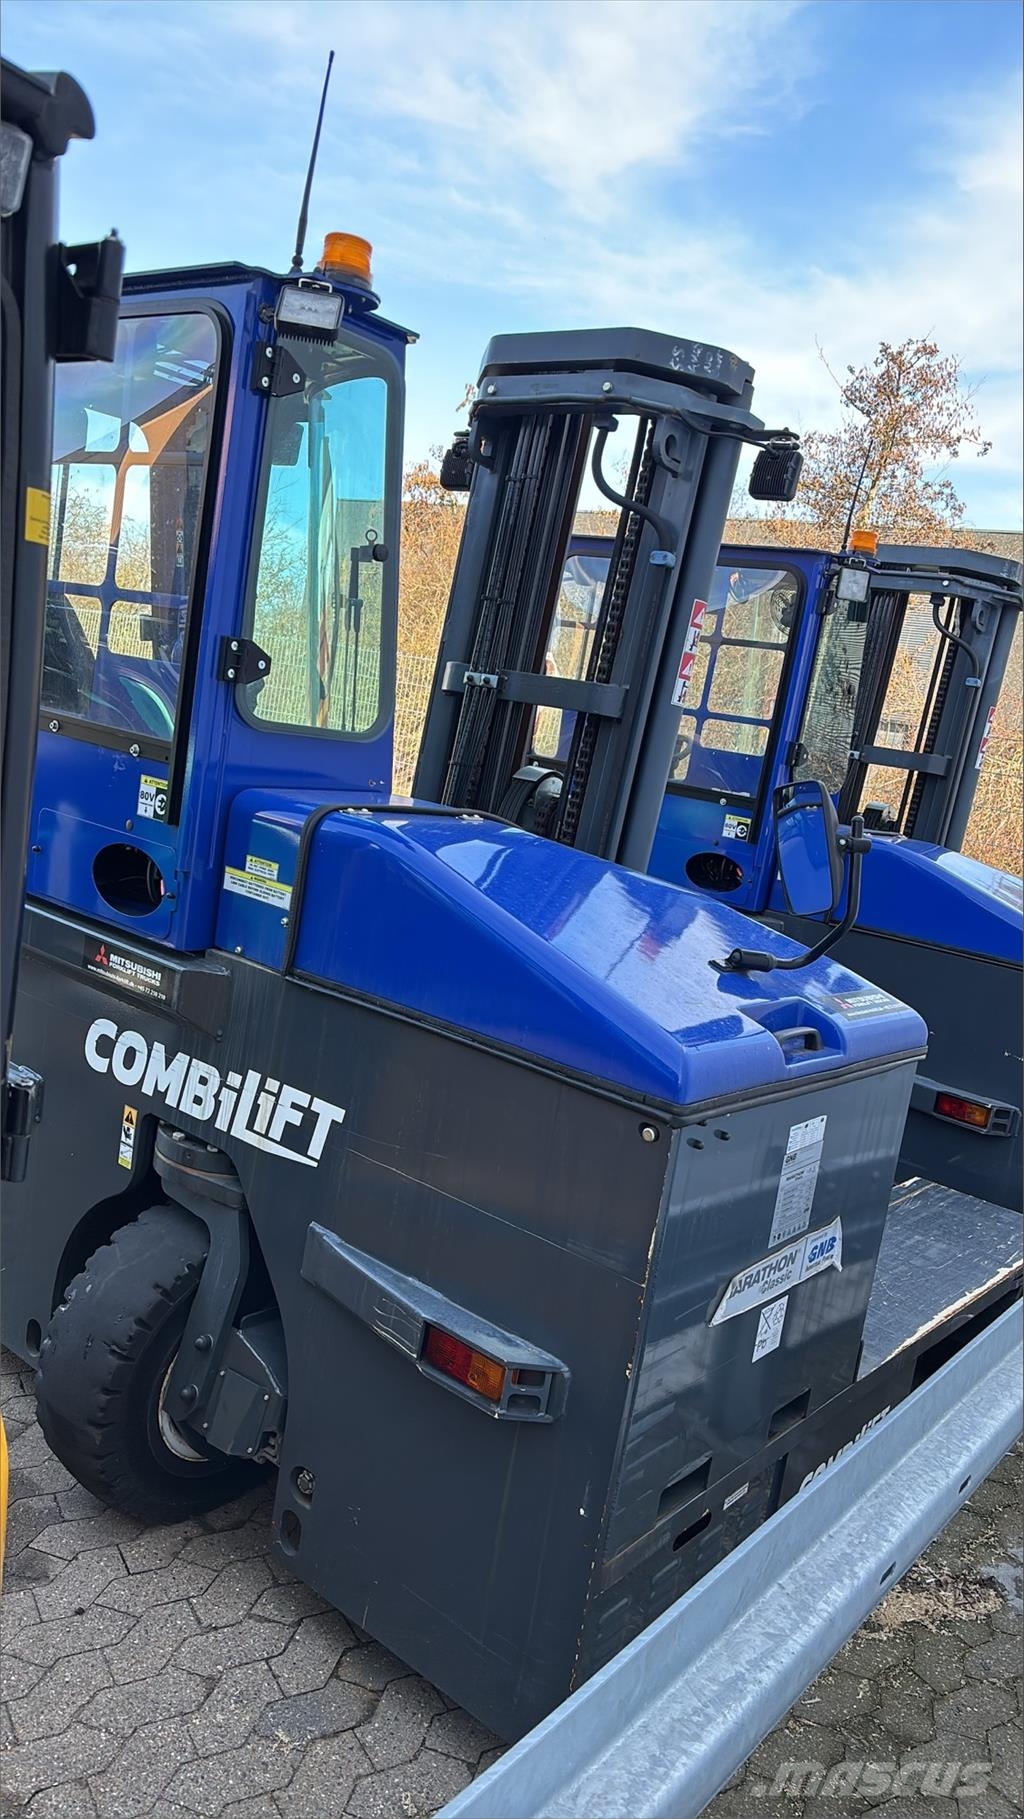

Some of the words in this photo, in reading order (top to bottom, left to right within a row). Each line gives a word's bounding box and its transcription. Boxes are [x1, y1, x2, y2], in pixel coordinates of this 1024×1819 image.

[140, 790, 155, 802] 80V
[109, 953, 162, 981] MITSUBISHI
[109, 962, 136, 977] FORKLIFT
[136, 972, 161, 987] TRUCKS
[808, 1236, 837, 1263] GNB
[760, 1269, 792, 1294] Classic
